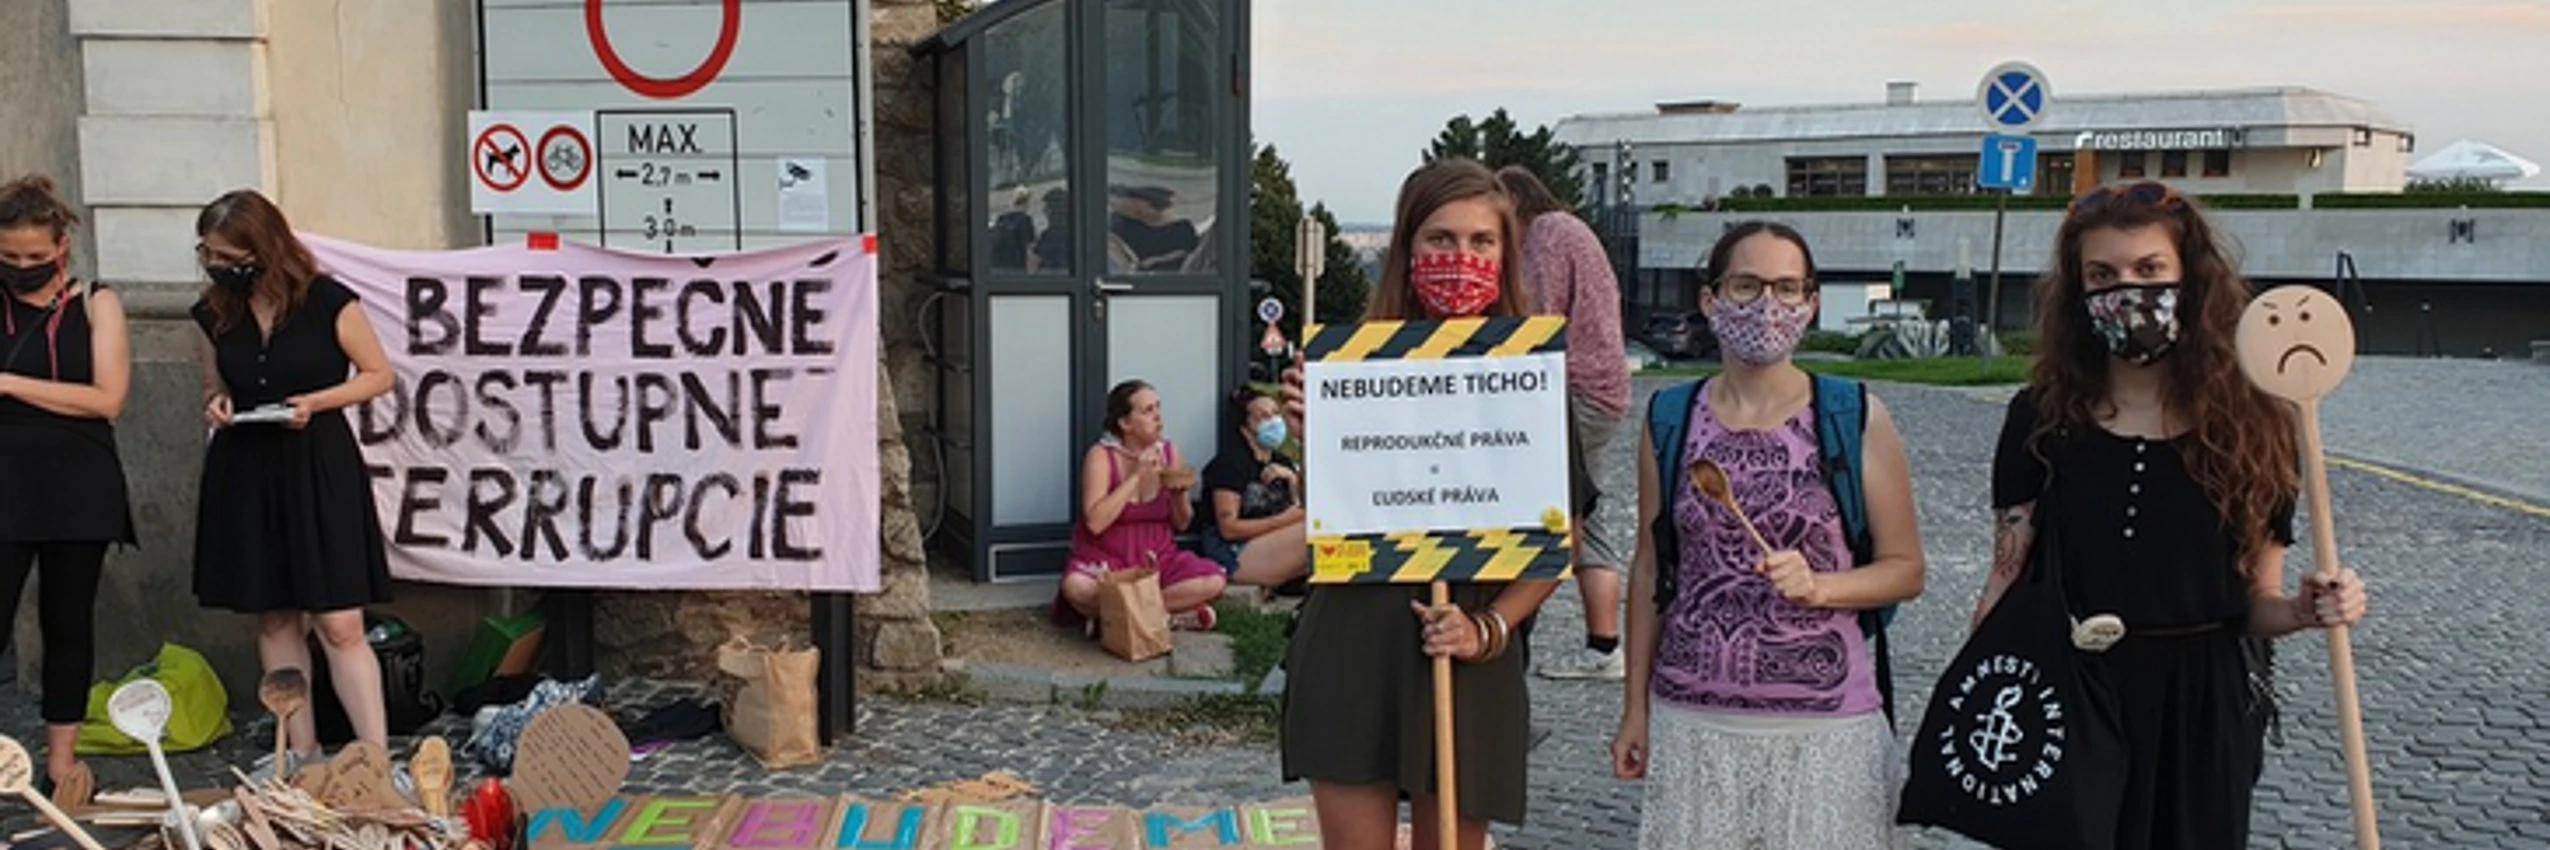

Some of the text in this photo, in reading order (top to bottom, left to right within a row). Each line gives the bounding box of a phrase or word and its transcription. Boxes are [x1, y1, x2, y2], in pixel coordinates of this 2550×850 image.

[627, 123, 702, 153] MAX.
[2094, 129, 2224, 150] restaurant
[405, 250, 839, 358] BEZPEČNÉ
[1320, 370, 1548, 399] NEBUDEME TICHO!
[1340, 428, 1530, 451] REPRODUKČNÉ PRÁVA
[1440, 483, 1500, 503] PRÁVA
[366, 465, 824, 561] ERRUPCIE
[1940, 686, 2065, 804] INTERNATIONAL
[528, 797, 1317, 850] NEBUDEME
